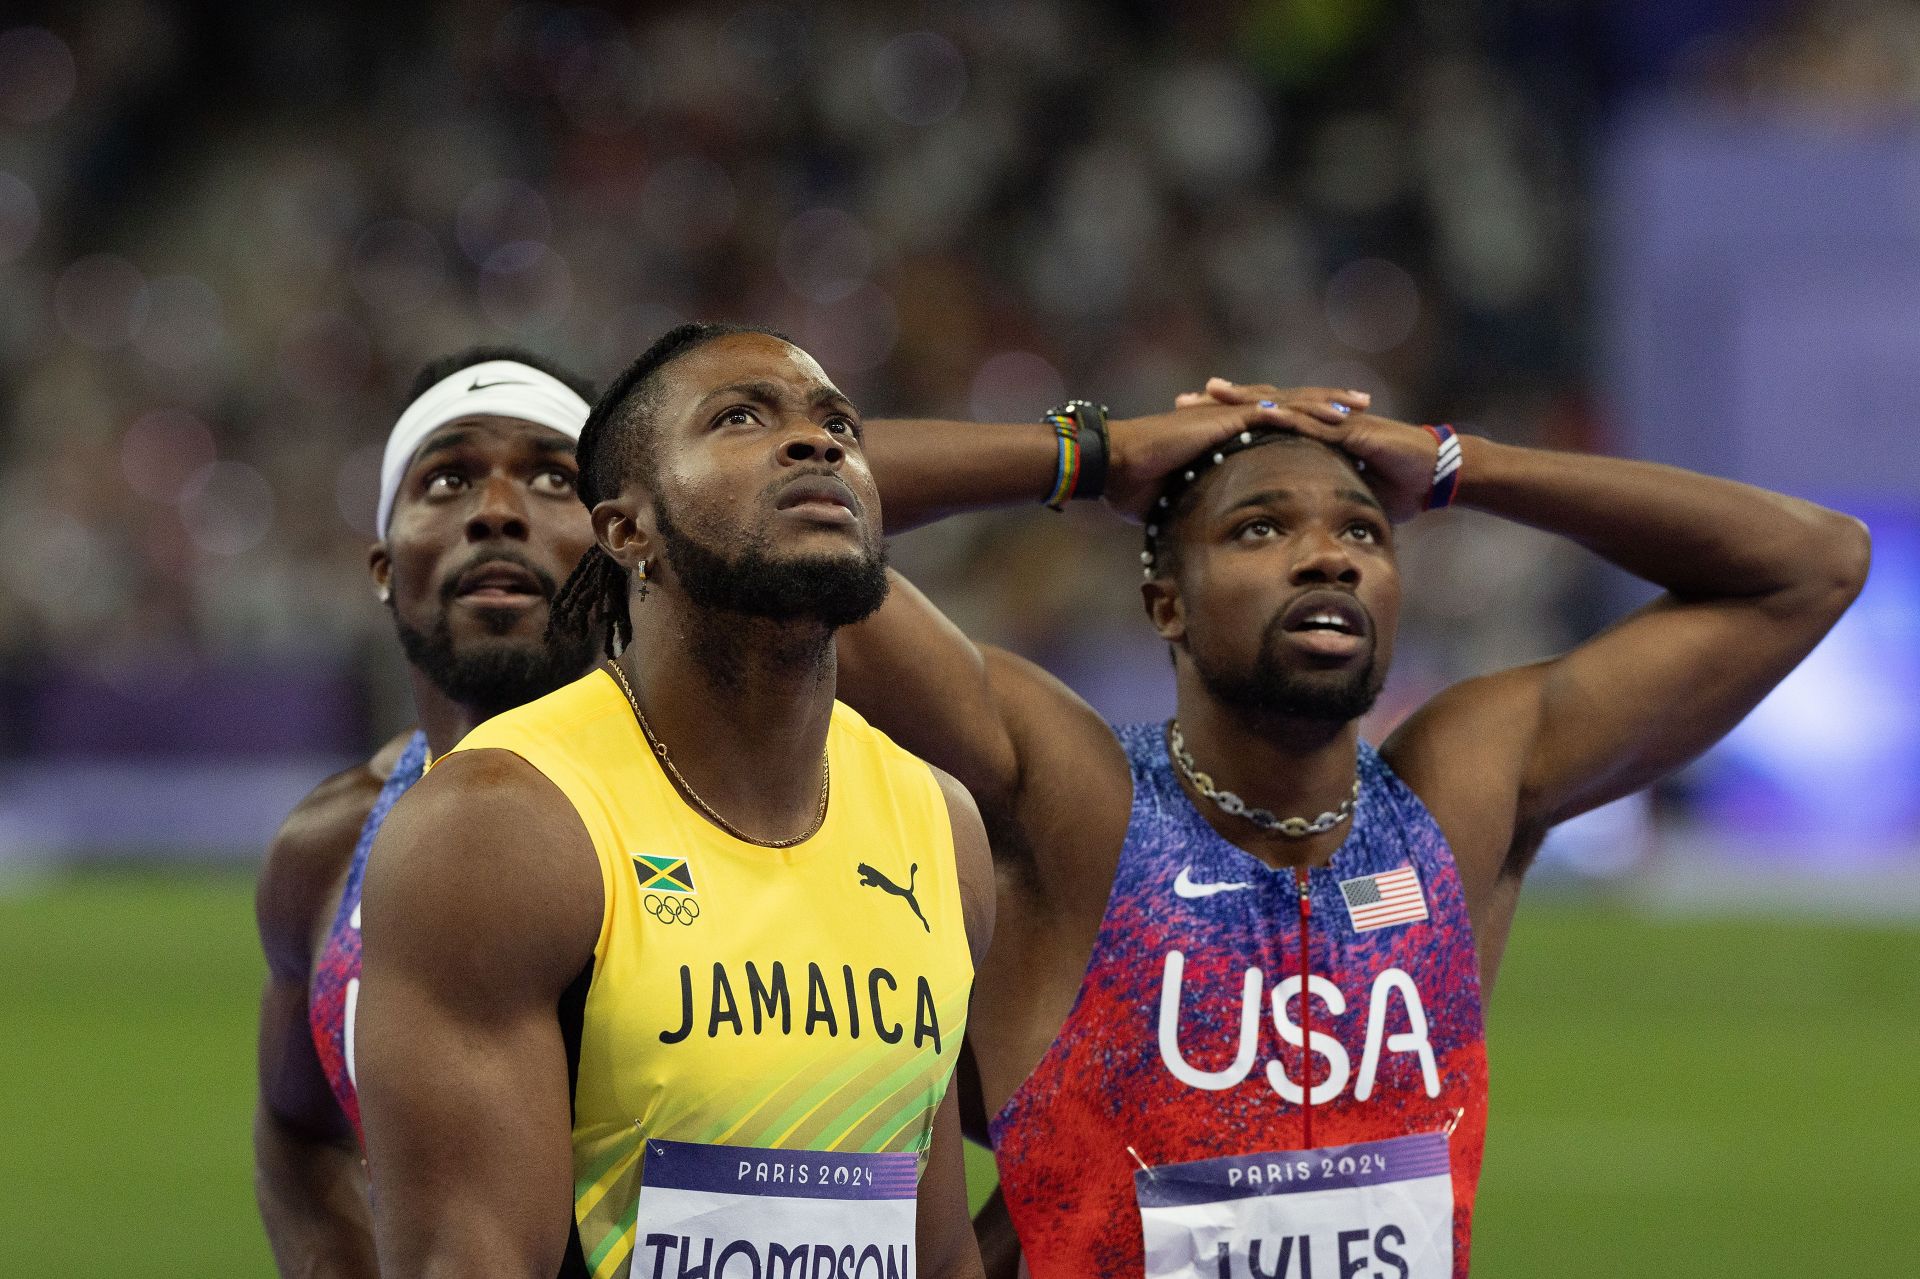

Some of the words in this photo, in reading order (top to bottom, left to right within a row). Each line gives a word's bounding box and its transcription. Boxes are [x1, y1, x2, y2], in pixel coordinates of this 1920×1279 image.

[659, 960, 941, 1055] JAMAICA
[1159, 950, 1441, 1105] USA
[818, 1165, 872, 1186] 2024
[1321, 1153, 1386, 1178] 2024
